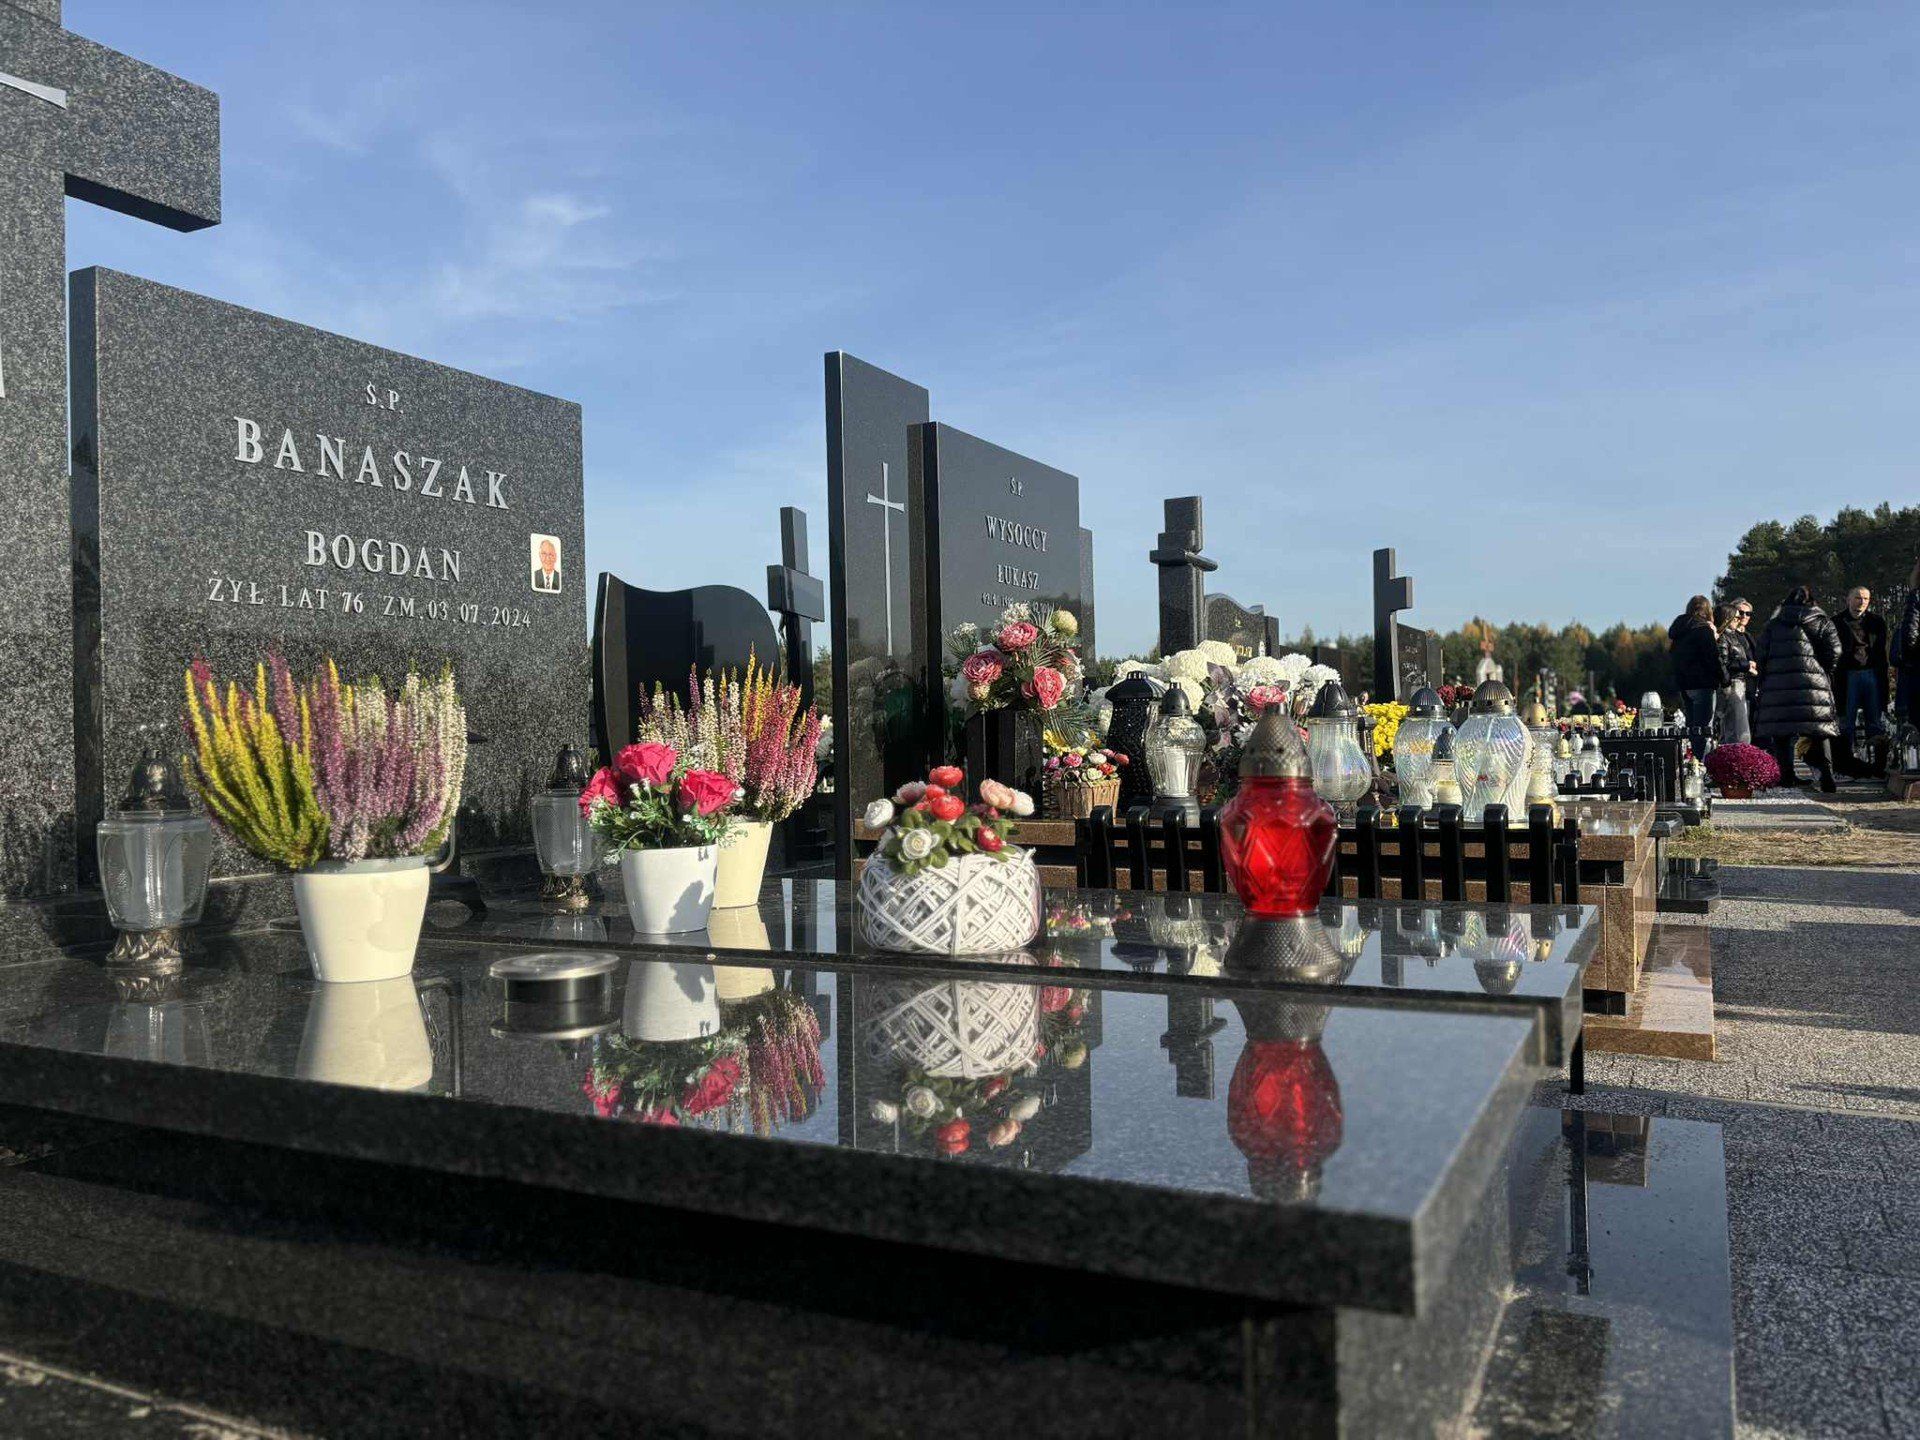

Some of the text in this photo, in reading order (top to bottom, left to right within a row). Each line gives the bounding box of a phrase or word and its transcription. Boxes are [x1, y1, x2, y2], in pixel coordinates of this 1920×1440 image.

[233, 416, 510, 510] BANASZAK
[304, 530, 462, 583] BOGDAN
[985, 514, 1048, 552] WYSOCCY
[208, 570, 264, 605] ŻYŁ
[278, 584, 329, 610] LAT
[341, 591, 364, 614] 76
